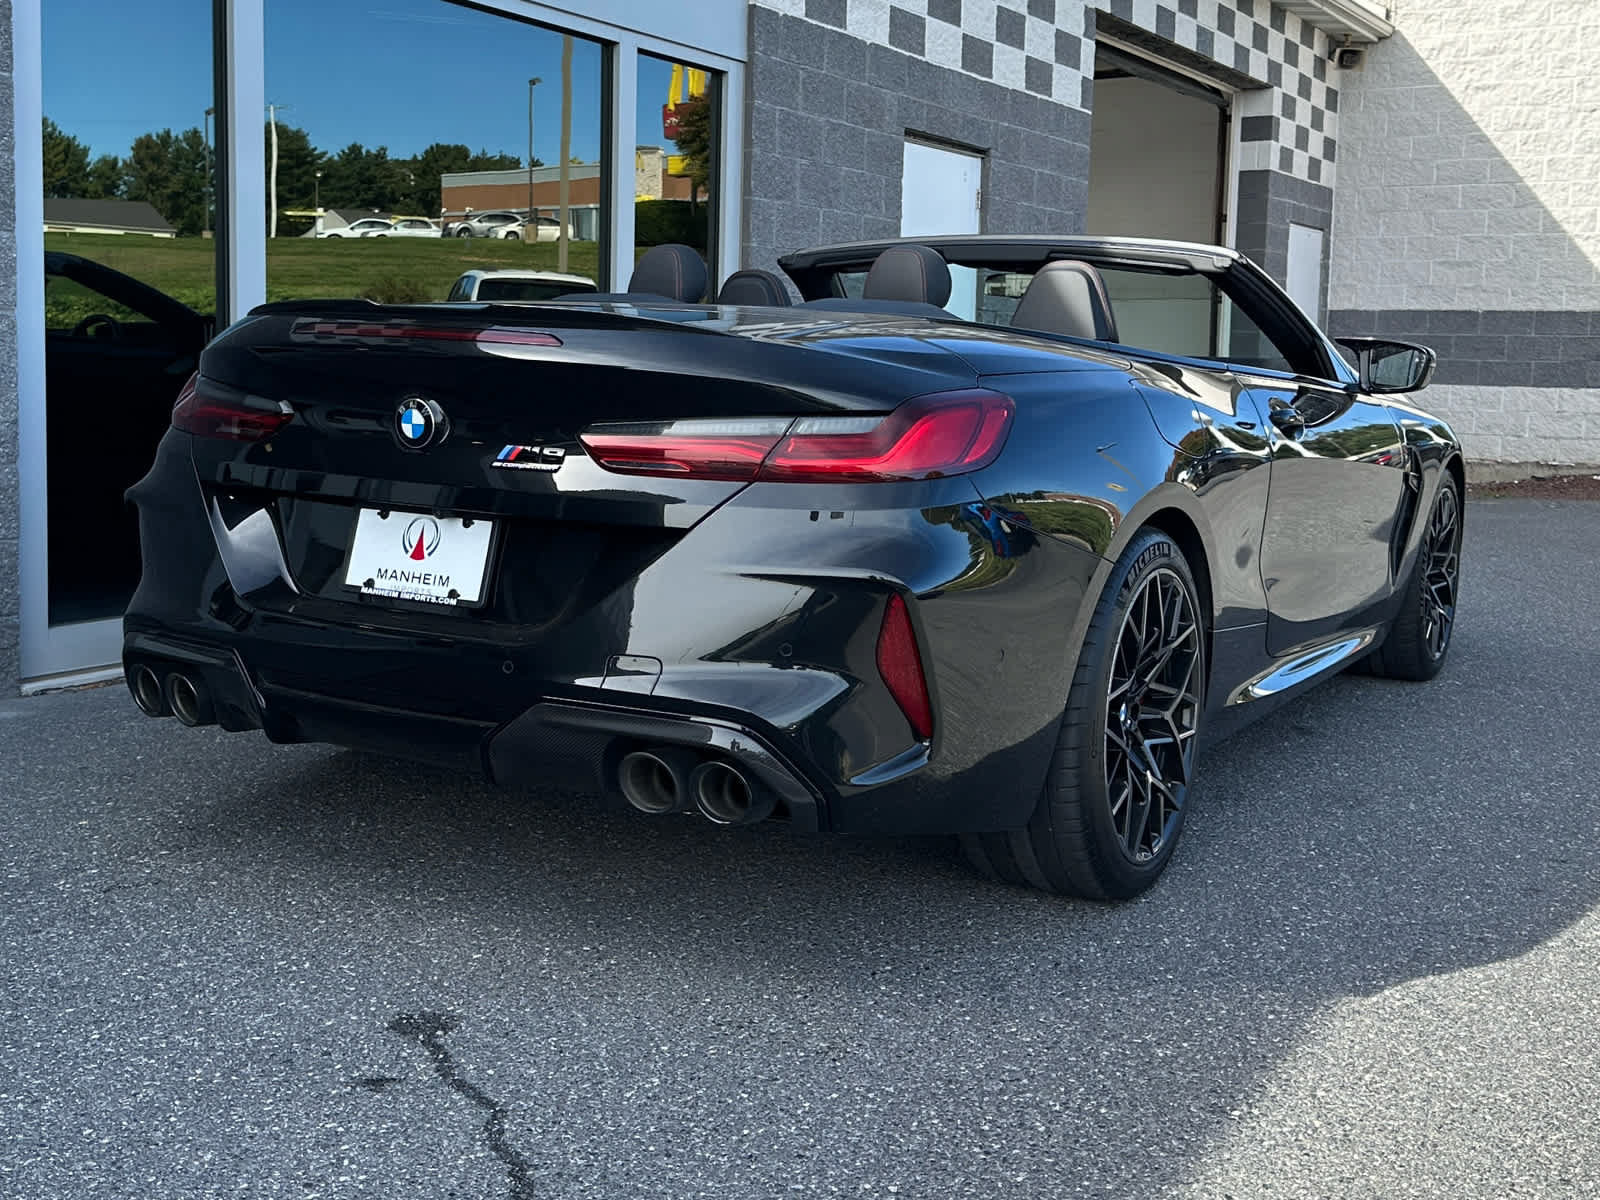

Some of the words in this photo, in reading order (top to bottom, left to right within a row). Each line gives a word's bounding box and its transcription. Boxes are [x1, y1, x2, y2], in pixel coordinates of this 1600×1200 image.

[1127, 543, 1170, 588] MICHELIN
[376, 568, 450, 587] MANHEIM
[360, 587, 399, 599] MANHEIM
